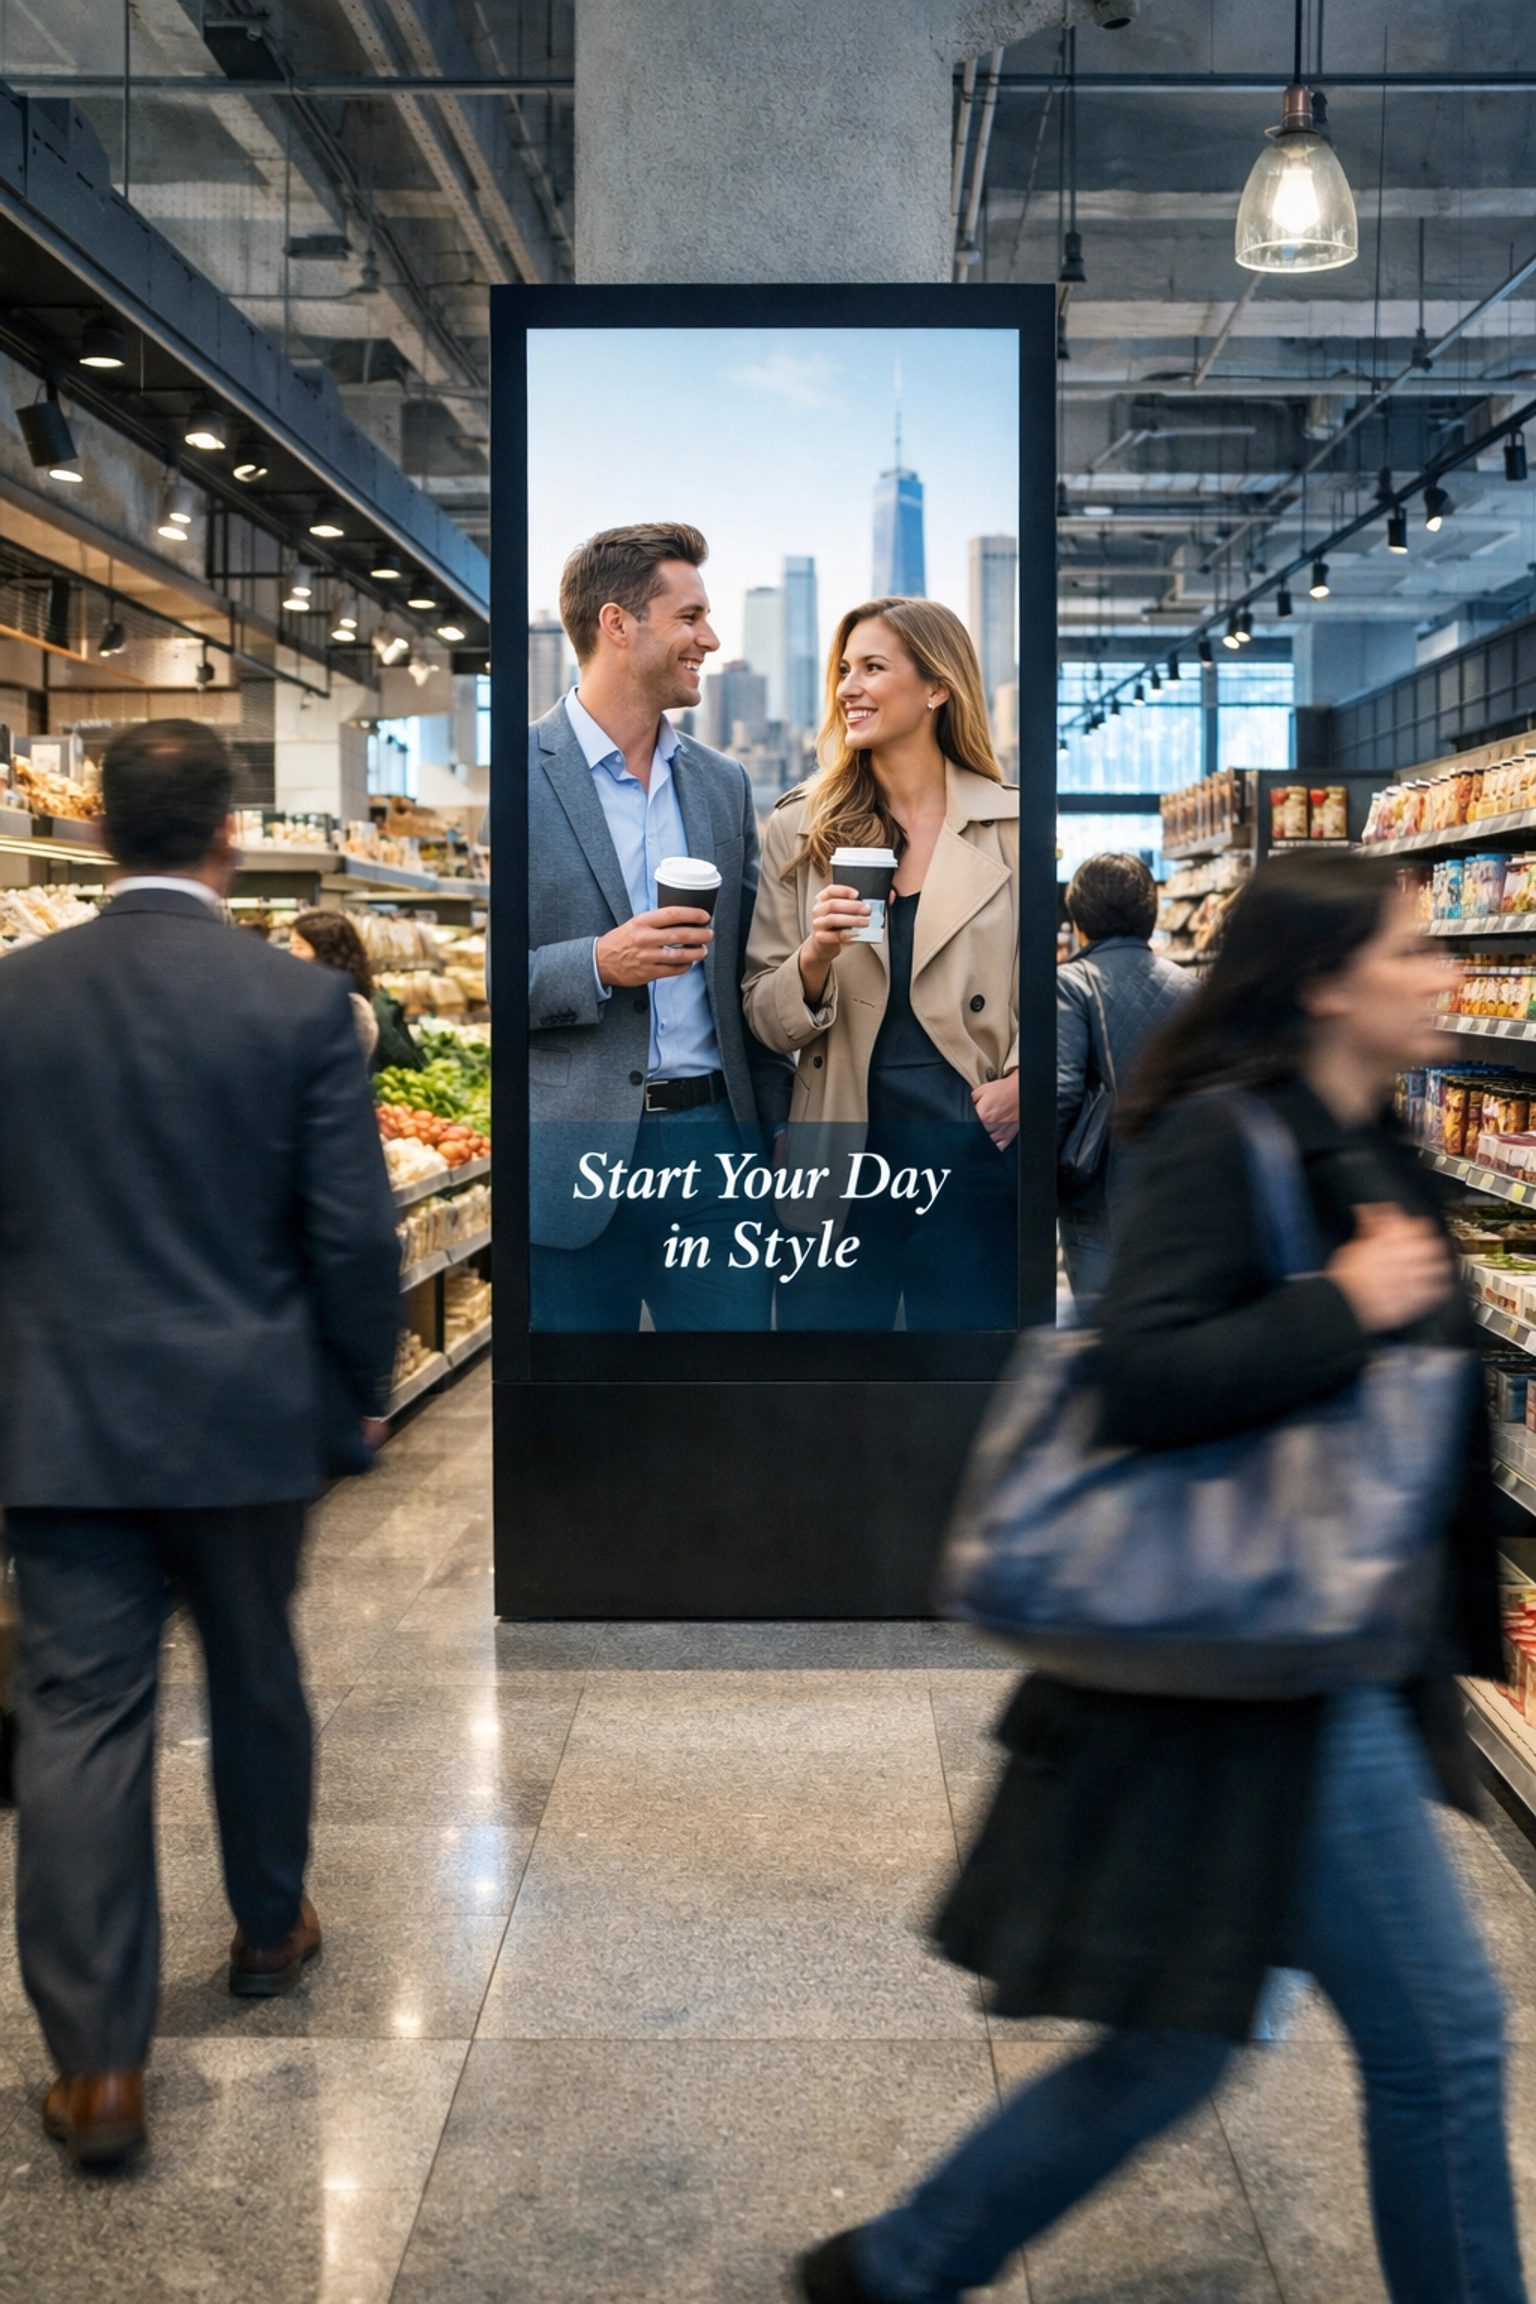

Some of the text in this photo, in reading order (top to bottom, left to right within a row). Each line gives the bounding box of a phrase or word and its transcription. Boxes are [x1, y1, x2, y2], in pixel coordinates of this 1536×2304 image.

[572, 1151, 952, 1216] Start Your Day
[662, 1219, 861, 1285] in Style
